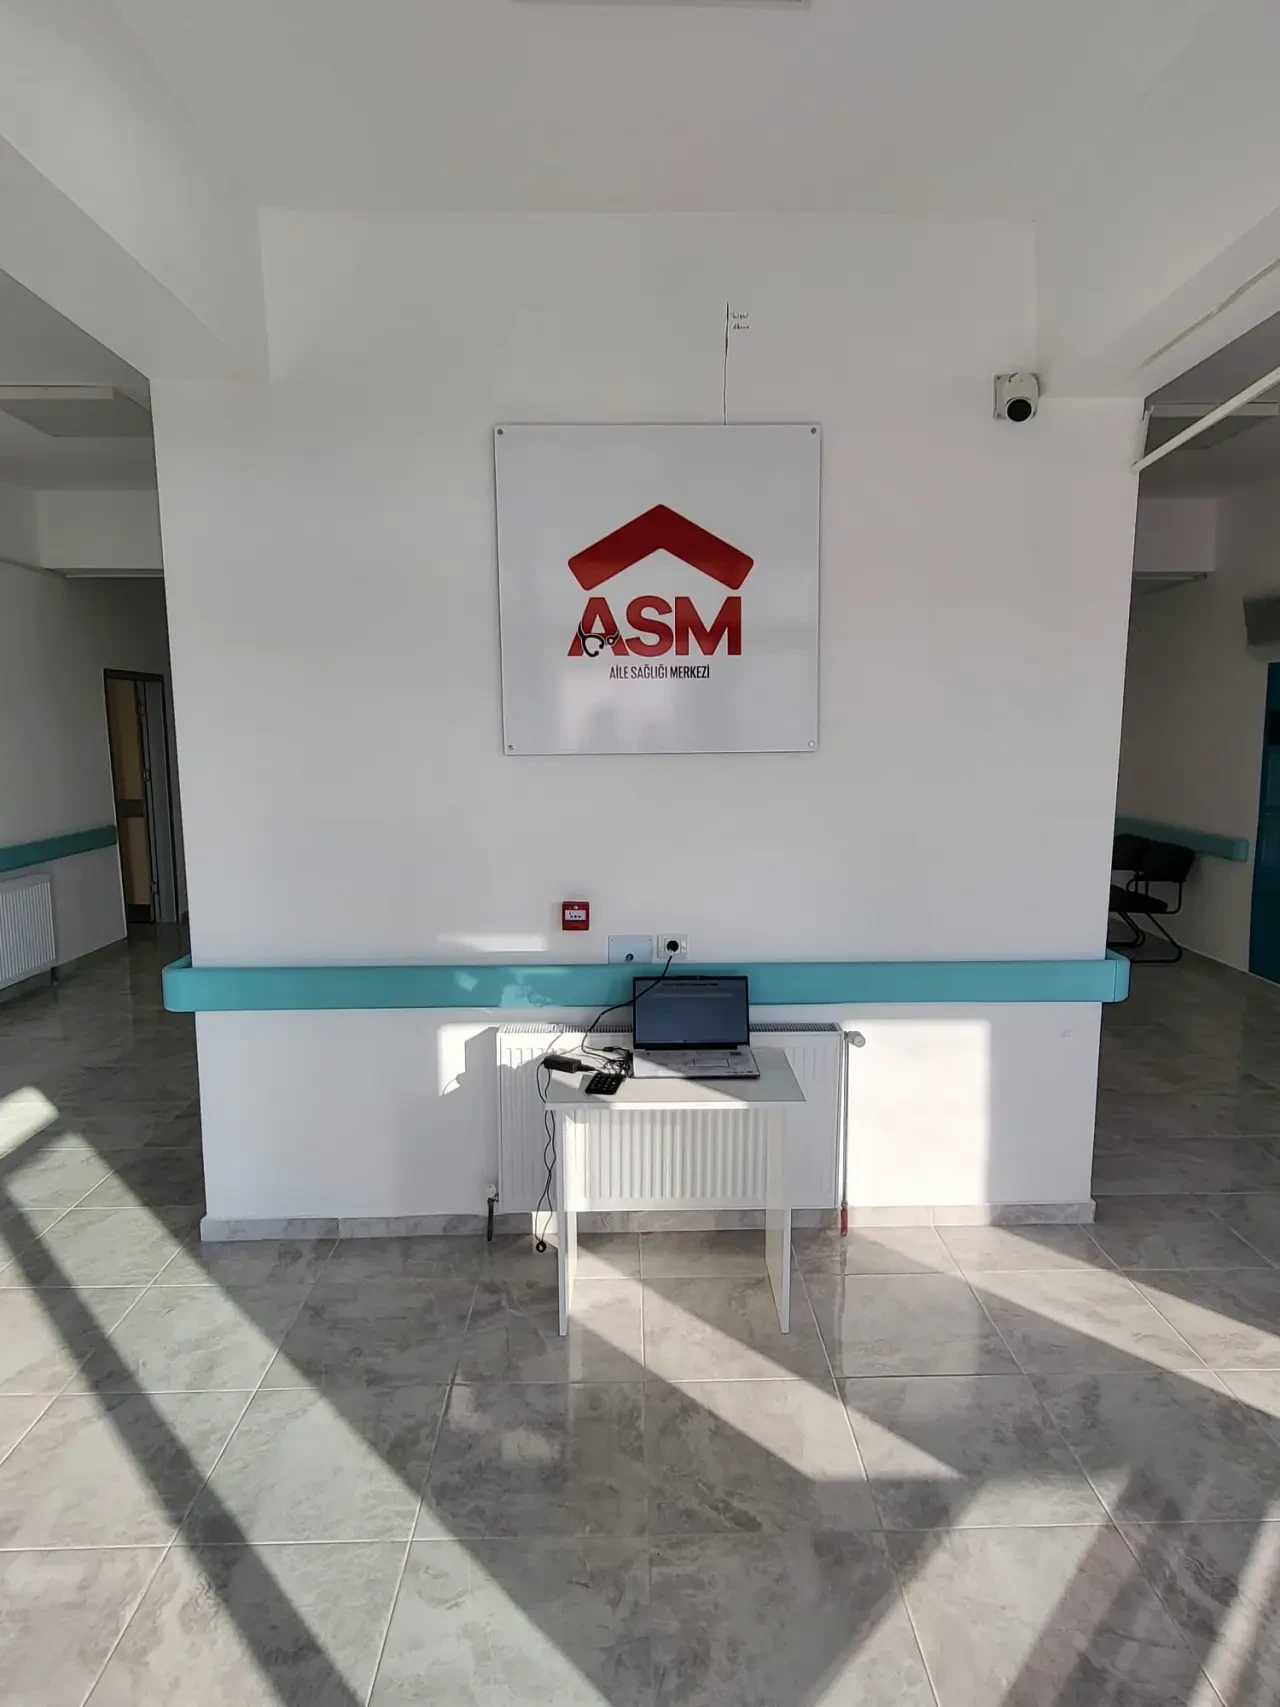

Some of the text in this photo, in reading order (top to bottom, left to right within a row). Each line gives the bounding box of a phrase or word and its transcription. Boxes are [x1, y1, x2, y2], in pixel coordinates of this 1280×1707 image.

[567, 595, 742, 657] ASM
[609, 664, 710, 679] AİLE SAĞLIĞI MERKEZİ
